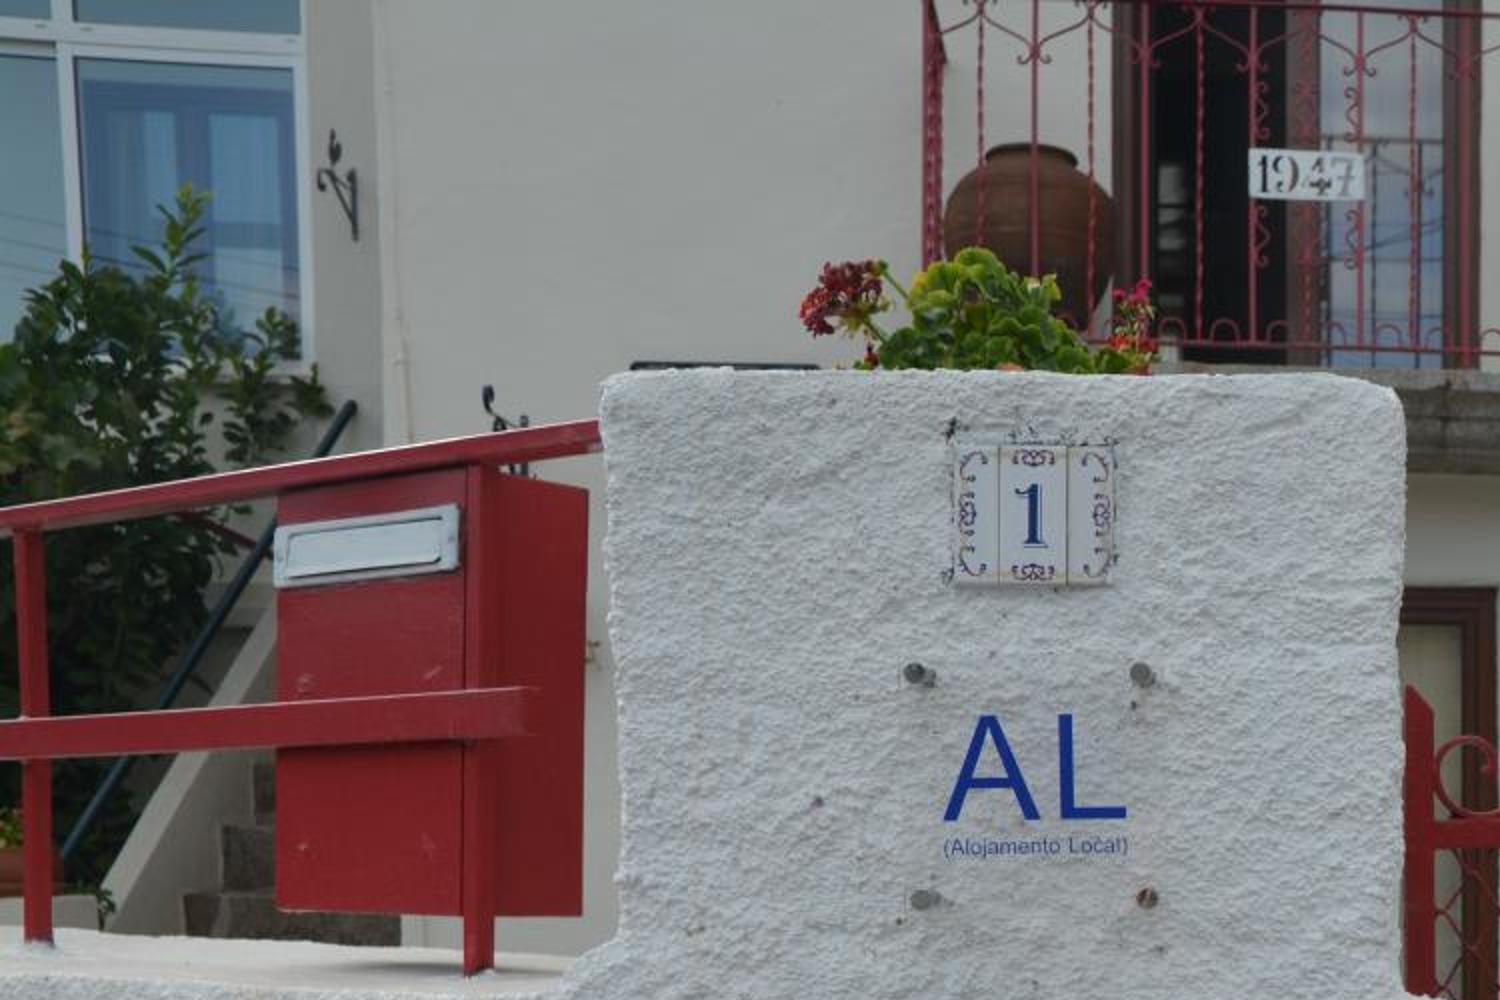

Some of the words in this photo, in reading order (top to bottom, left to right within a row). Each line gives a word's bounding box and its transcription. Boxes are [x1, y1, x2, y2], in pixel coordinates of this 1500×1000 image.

[1258, 155, 1356, 196] 1947
[1015, 483, 1048, 548] 1
[943, 713, 1127, 821] AL
[943, 837, 1061, 859] (Alojamento
[1068, 835, 1128, 857] Local)
